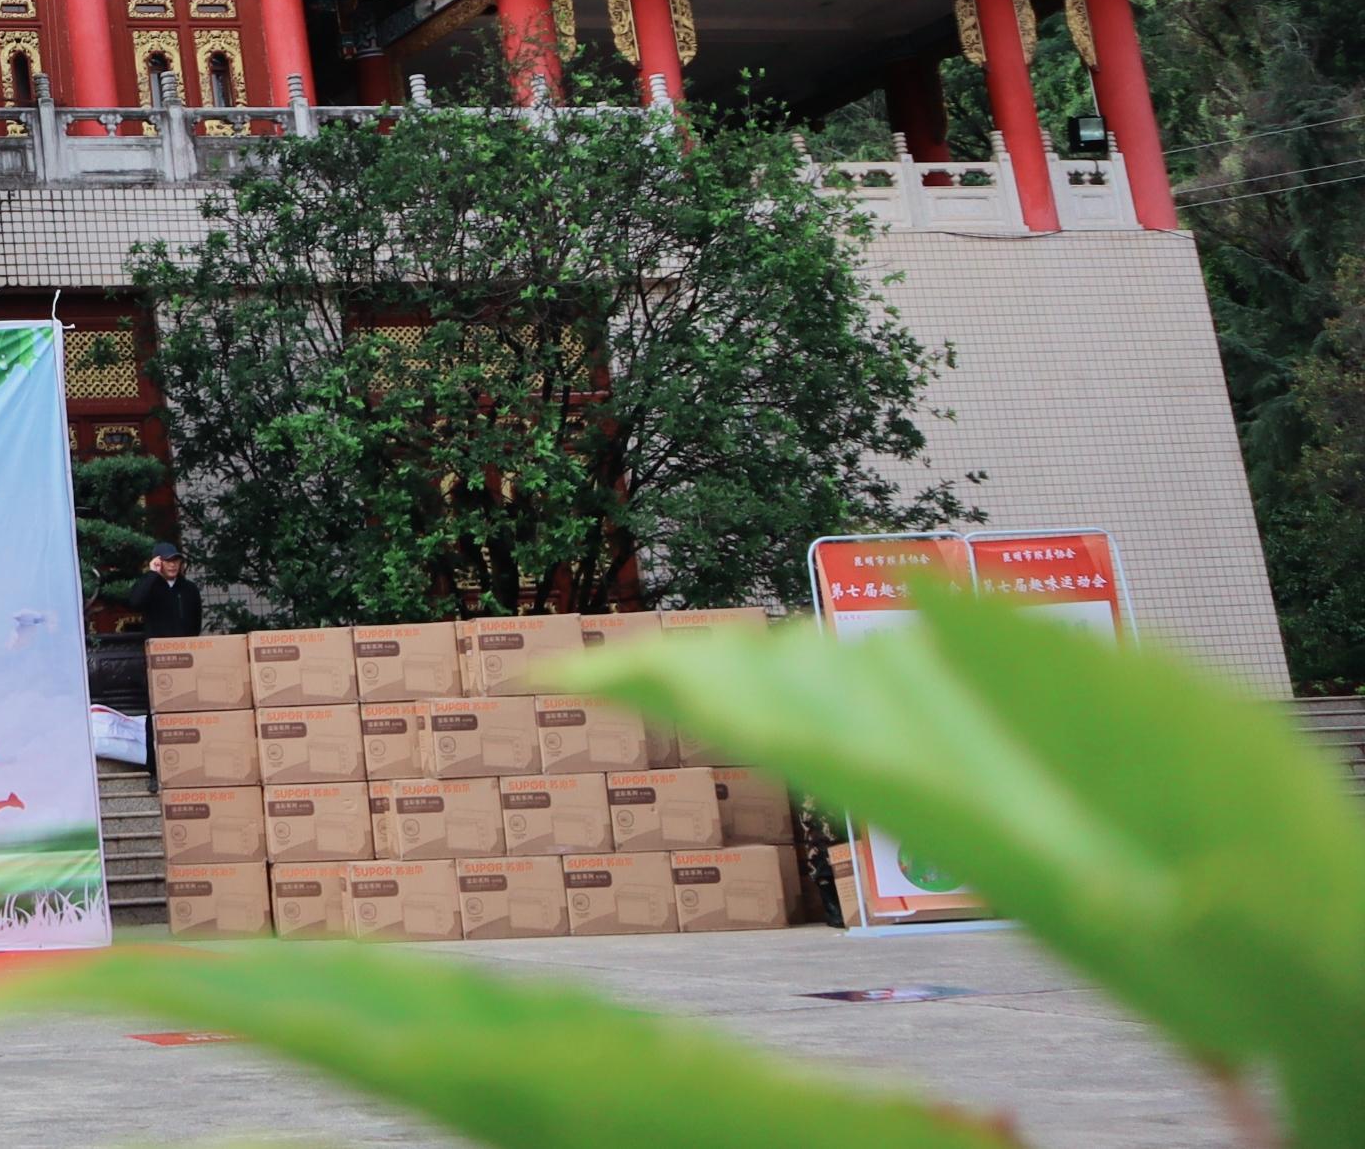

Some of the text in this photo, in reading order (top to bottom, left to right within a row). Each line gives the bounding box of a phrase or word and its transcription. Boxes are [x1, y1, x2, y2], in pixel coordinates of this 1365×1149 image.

[260, 634, 294, 644] SUPOR
[355, 865, 392, 876] SUPOR
[465, 863, 502, 873] SUPOR
